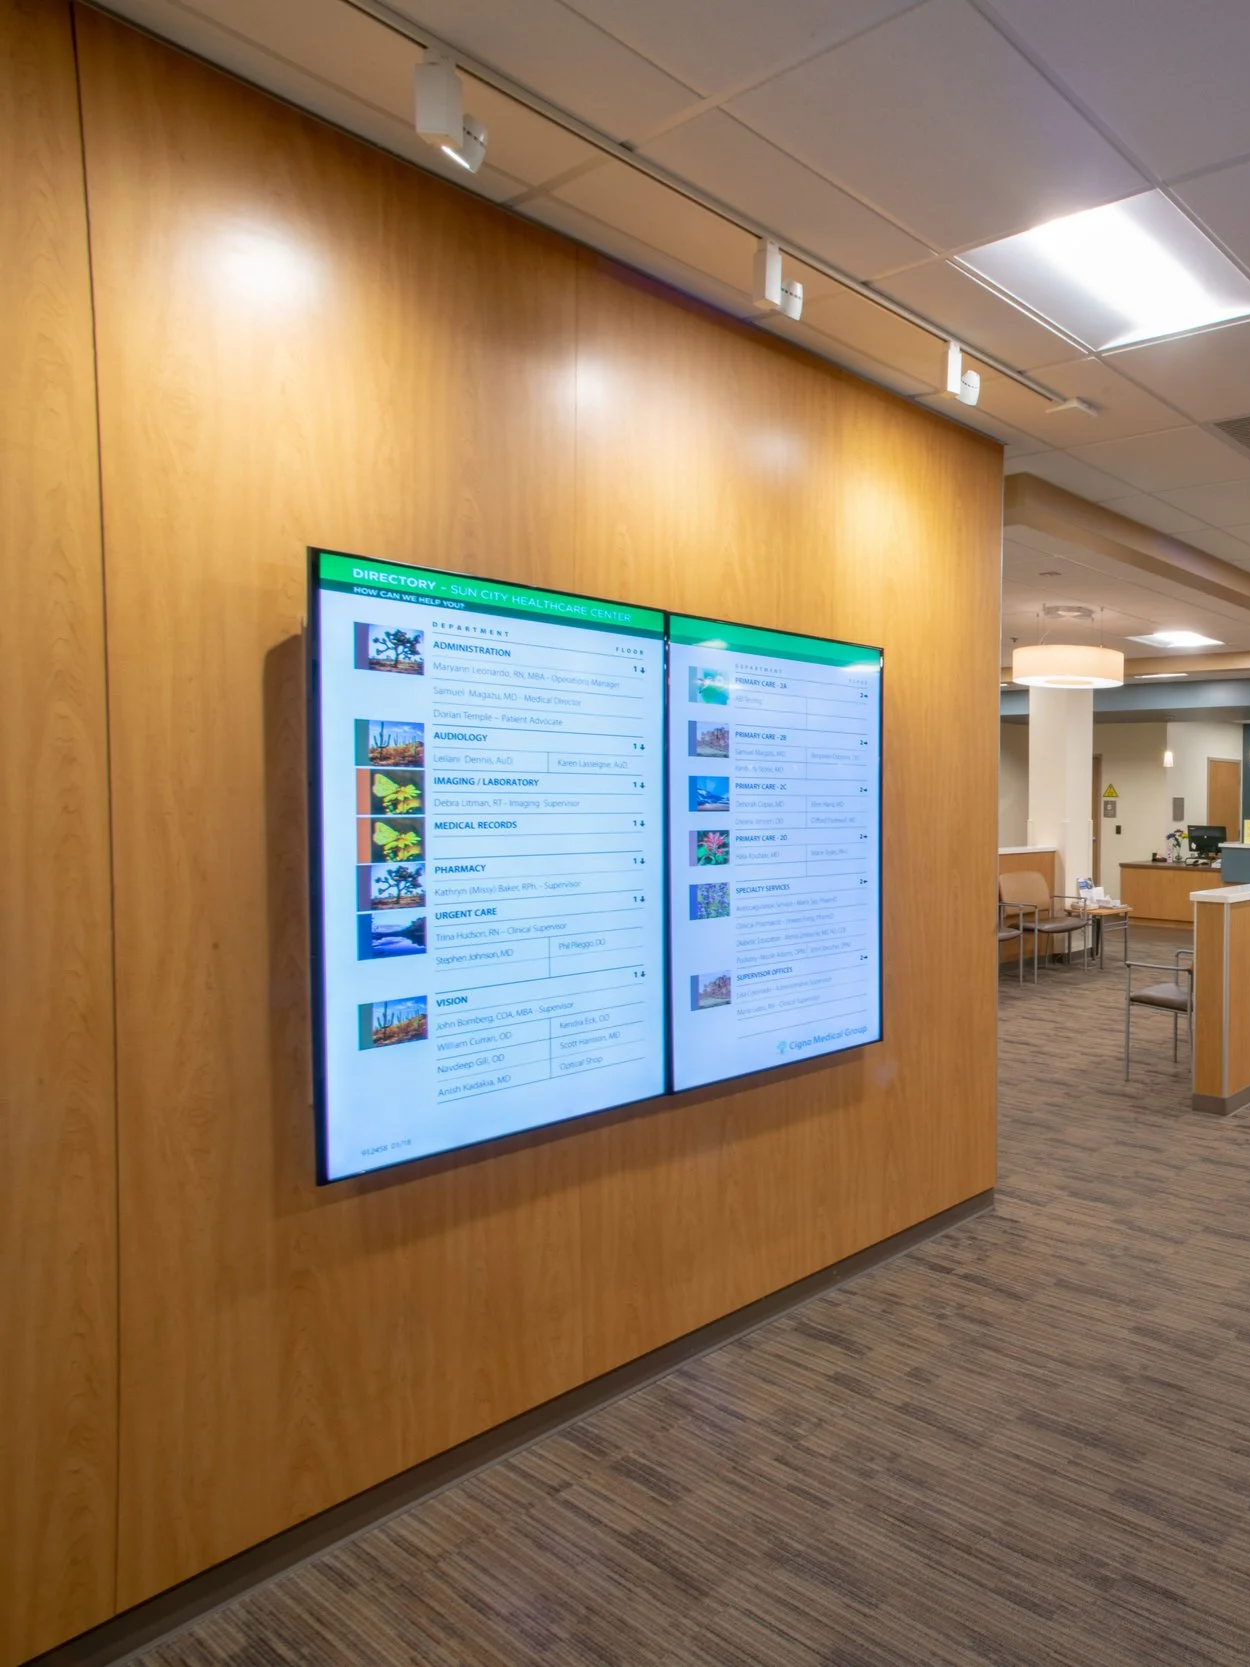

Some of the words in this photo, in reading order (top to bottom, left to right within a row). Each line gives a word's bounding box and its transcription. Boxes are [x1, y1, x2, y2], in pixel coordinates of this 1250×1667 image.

[352, 568, 437, 591] DIRECTORY
[449, 584, 478, 598] SUN
[480, 590, 509, 603] CITY
[511, 594, 588, 616] HEALTHCARE
[590, 607, 632, 622] CENTER
[353, 586, 377, 597] HOW
[379, 591, 400, 601] CAN
[401, 594, 417, 603] WE
[419, 596, 441, 607] HELP
[442, 599, 465, 610] YOU?
[432, 621, 511, 638] DEPARTMENT
[432, 641, 512, 658] ADMINISTRATION
[615, 646, 645, 656] FLOOR
[432, 662, 470, 674] Maryann
[527, 672, 545, 682] MBA
[591, 679, 620, 690] Manager
[633, 665, 638, 673] 1
[735, 677, 760, 687] PRIMARY
[761, 680, 776, 689] CARE
[432, 686, 465, 697] Samuel
[503, 693, 517, 701] MD
[523, 694, 553, 705] Medical
[553, 696, 582, 707] Director
[432, 709, 461, 719] Dorian
[462, 712, 493, 723] Temple
[501, 714, 528, 725] Patient
[529, 715, 564, 726] Advocate
[433, 732, 488, 743] AUDIOLOGY
[735, 731, 760, 740] PRIMARY
[761, 733, 776, 741] CARE
[557, 759, 578, 768] Karen
[433, 776, 475, 786] IMAGING
[482, 778, 540, 787] LABORATORY
[433, 799, 460, 808] Debra
[509, 799, 540, 809] Imaging
[543, 799, 580, 809] Supervisor
[434, 821, 476, 830] MEDICAL
[477, 820, 518, 830] RECORDS
[434, 864, 487, 874] PHARMACY
[633, 857, 638, 865] 1
[434, 887, 467, 898] Kathryn
[469, 884, 496, 896] (Missy)
[544, 880, 582, 891] Supervisor
[735, 885, 765, 895] SPECIALTY
[765, 883, 791, 892] SERVICES
[435, 909, 473, 920] URGENT
[474, 907, 498, 918] CARE
[436, 933, 455, 943] Trina
[488, 928, 500, 937] RN
[507, 926, 532, 935] Clinical
[533, 922, 568, 934] Supervisor
[435, 953, 467, 966] Stephen
[500, 948, 514, 958] MD
[633, 971, 638, 979] 1
[735, 969, 771, 982] SUPERVISOR
[771, 966, 793, 977] OFFICES
[435, 996, 468, 1008] VISION
[435, 1020, 456, 1032] John
[515, 1007, 533, 1018] MBA
[538, 1001, 575, 1014] Supervisor
[436, 1041, 468, 1053] William
[498, 1031, 512, 1040] OD
[559, 1040, 578, 1050] Scott
[608, 1030, 621, 1040] MD
[789, 1039, 813, 1052] Cigna
[813, 1030, 844, 1045] Medical
[844, 1025, 868, 1038] Group
[491, 1053, 505, 1064] OD
[559, 1060, 586, 1072] Optical
[586, 1055, 603, 1067] Shop
[437, 1086, 462, 1097] Anish
[496, 1074, 512, 1085] MD
